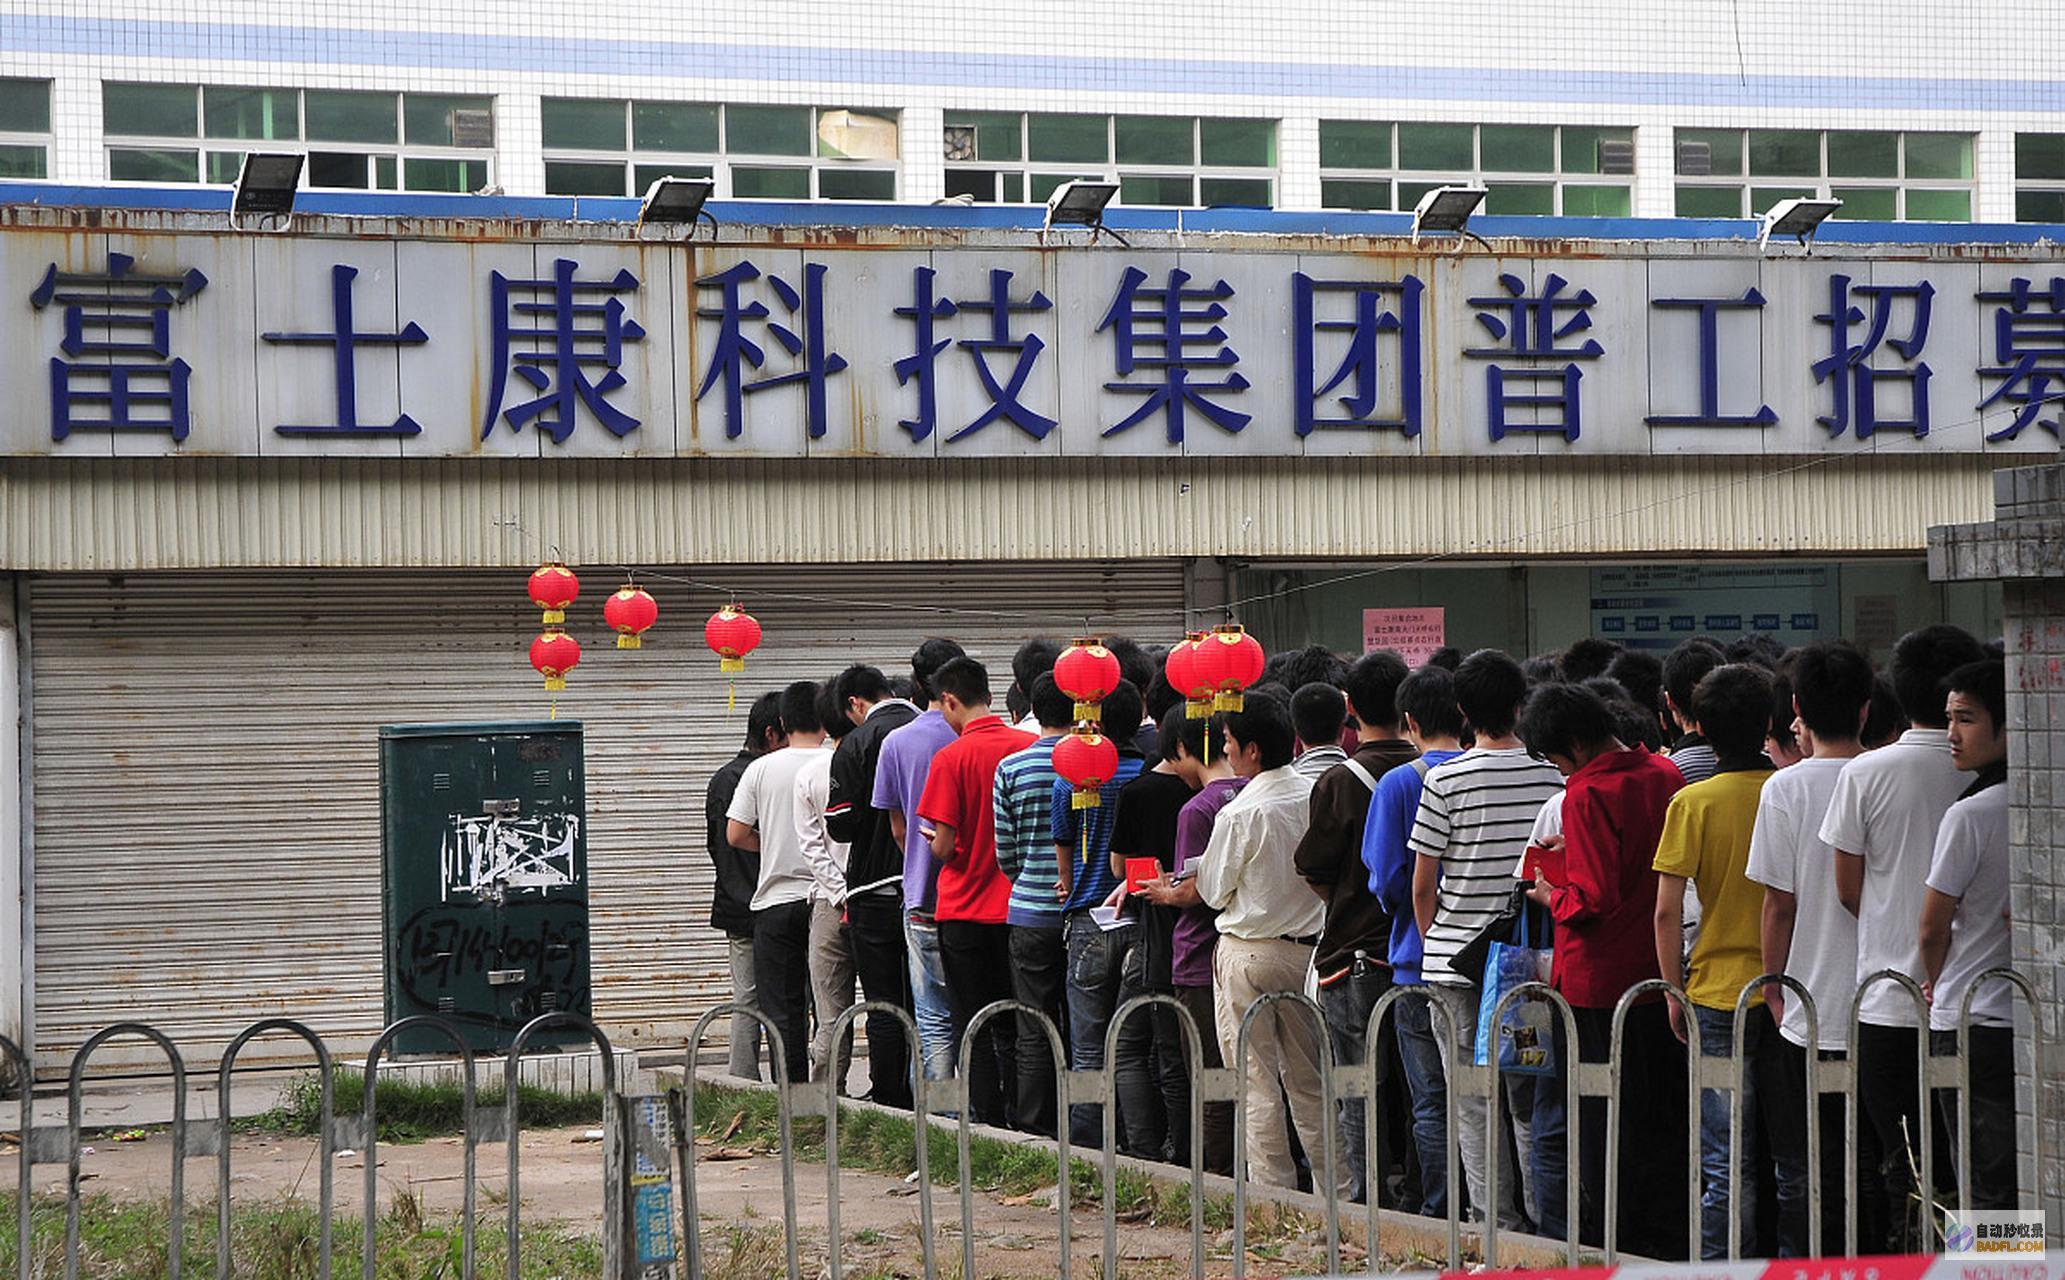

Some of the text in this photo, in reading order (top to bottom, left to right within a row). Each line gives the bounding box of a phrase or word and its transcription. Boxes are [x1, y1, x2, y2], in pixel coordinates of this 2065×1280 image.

[30, 252, 2065, 444] 富士康科技集团普工招募
